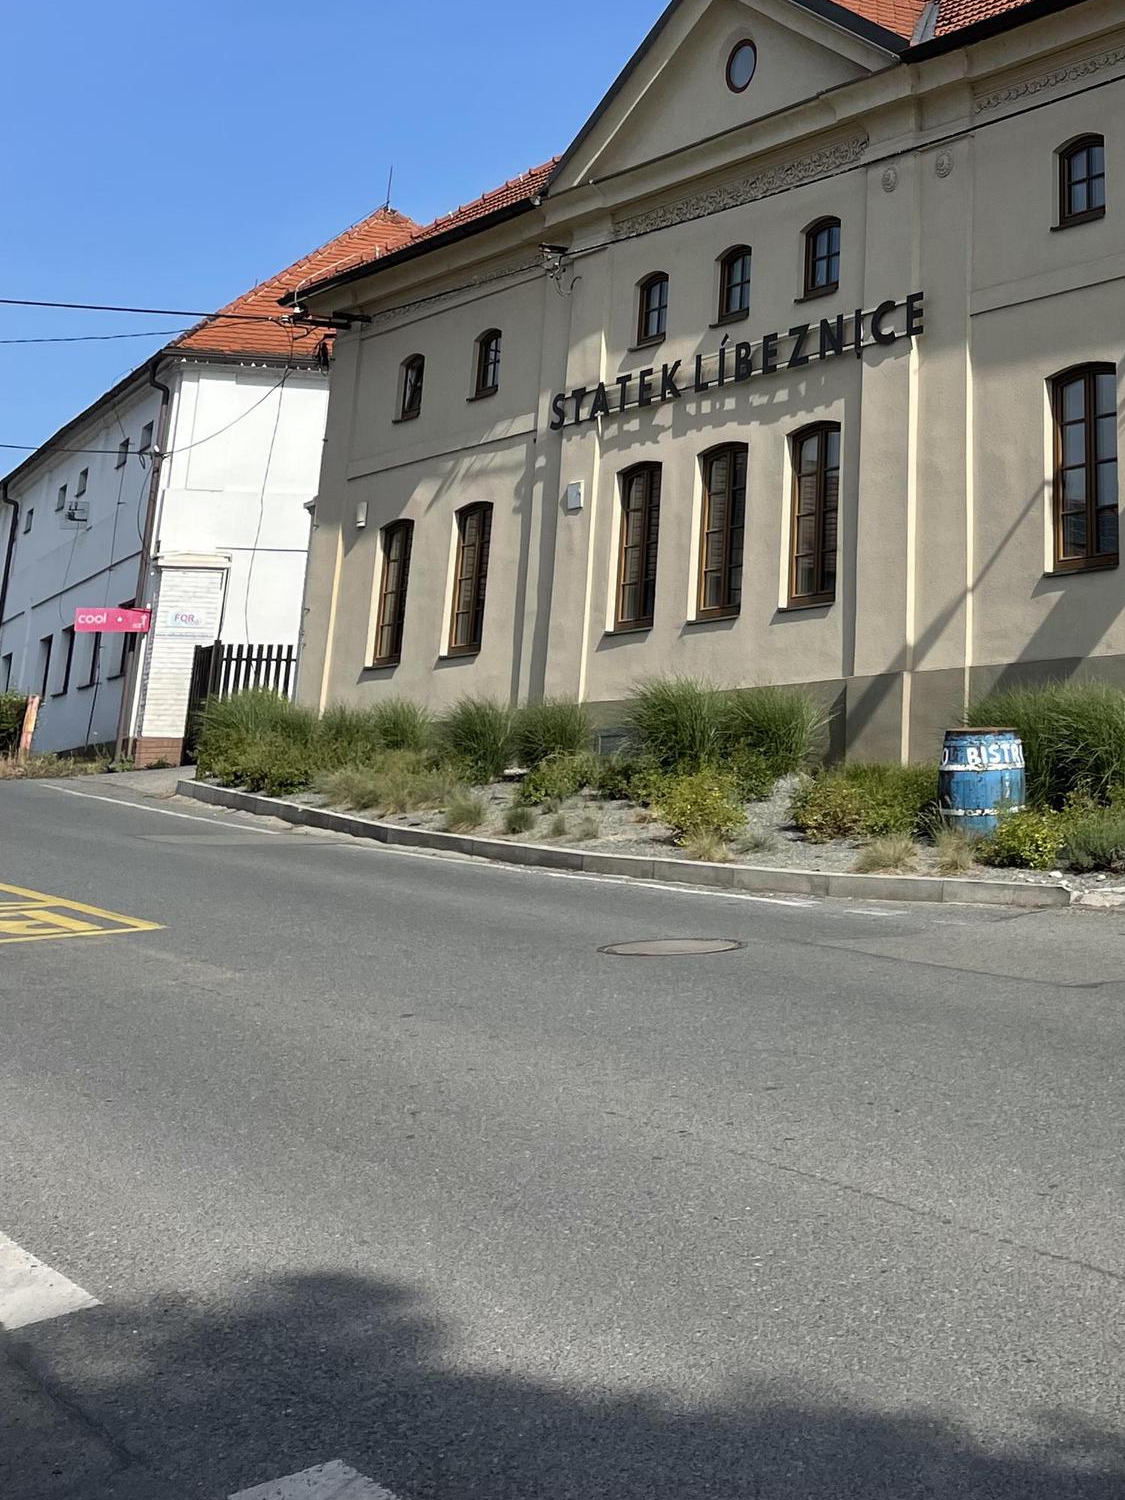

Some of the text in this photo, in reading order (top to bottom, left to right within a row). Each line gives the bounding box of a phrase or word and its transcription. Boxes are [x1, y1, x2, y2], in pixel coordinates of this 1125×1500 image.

[550, 291, 924, 430] STATEK LÍBEZNICE
[78, 613, 107, 624] cool
